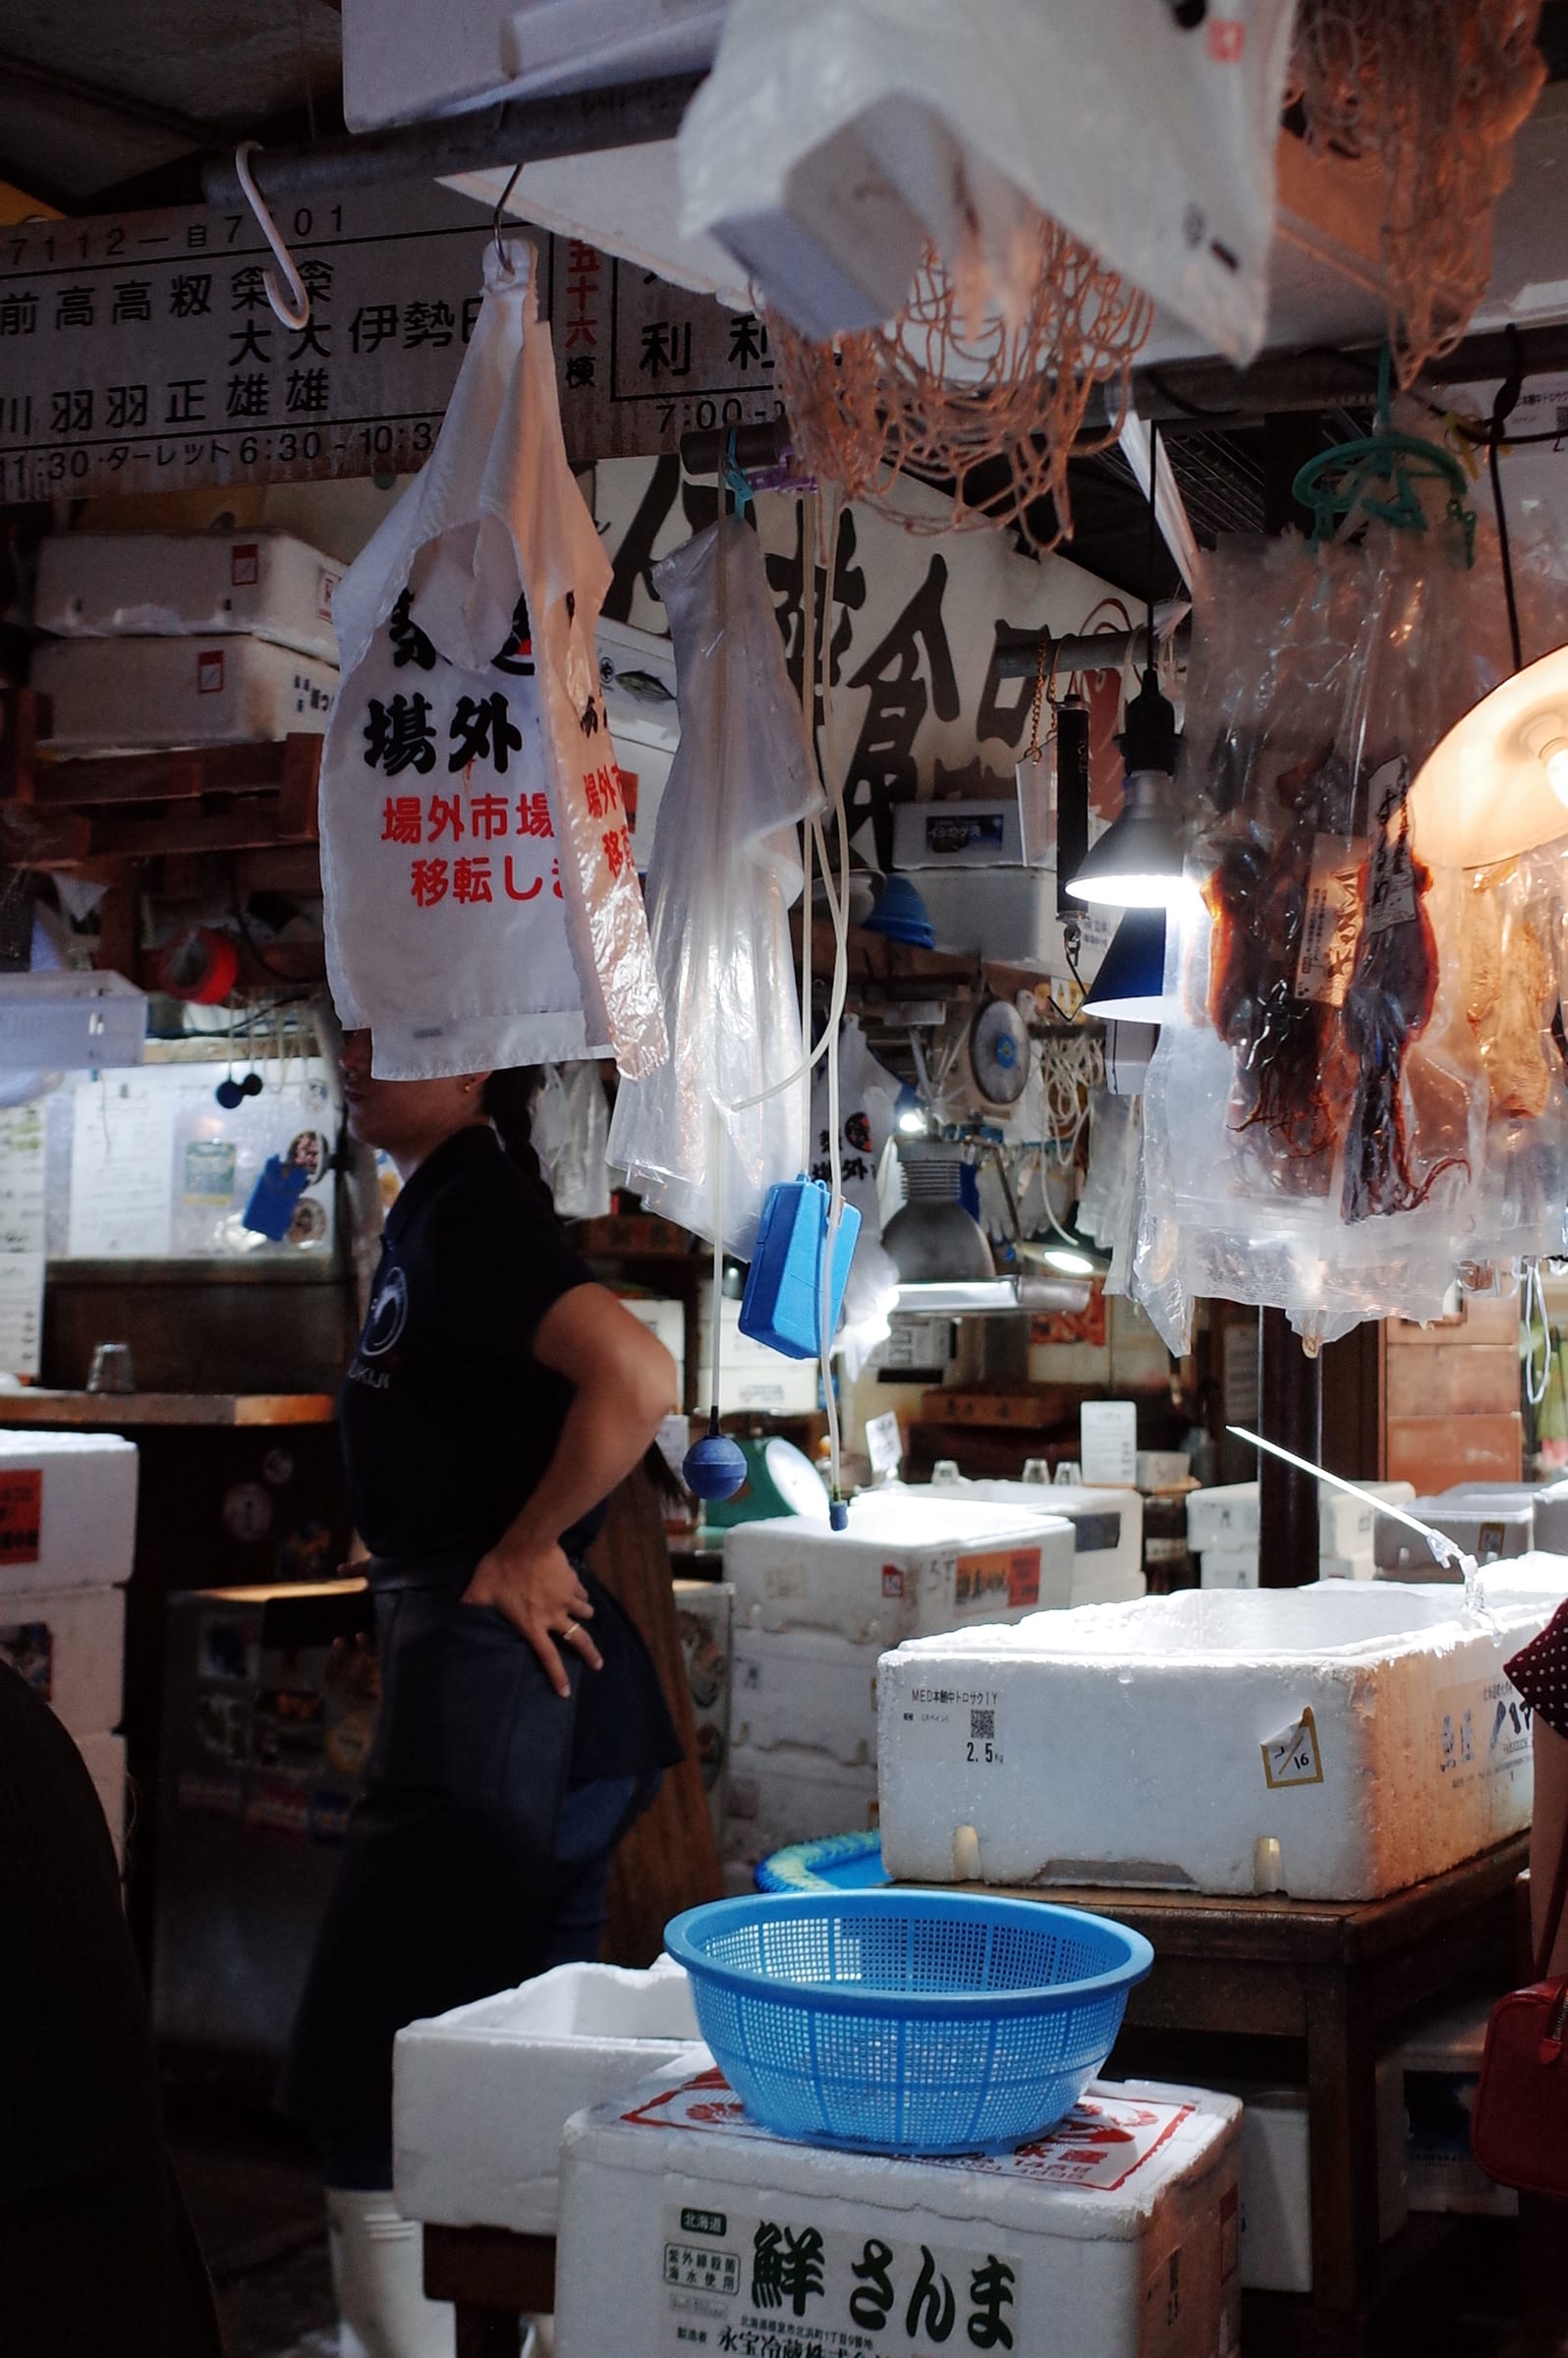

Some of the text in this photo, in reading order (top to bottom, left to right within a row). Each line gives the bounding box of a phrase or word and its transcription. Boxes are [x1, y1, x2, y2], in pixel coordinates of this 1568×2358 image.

[364, 692, 523, 776] 場外
[381, 792, 555, 845] 場外市場
[684, 2212, 721, 2233] 北海道
[752, 2218, 1016, 2351] 鮮さんま
